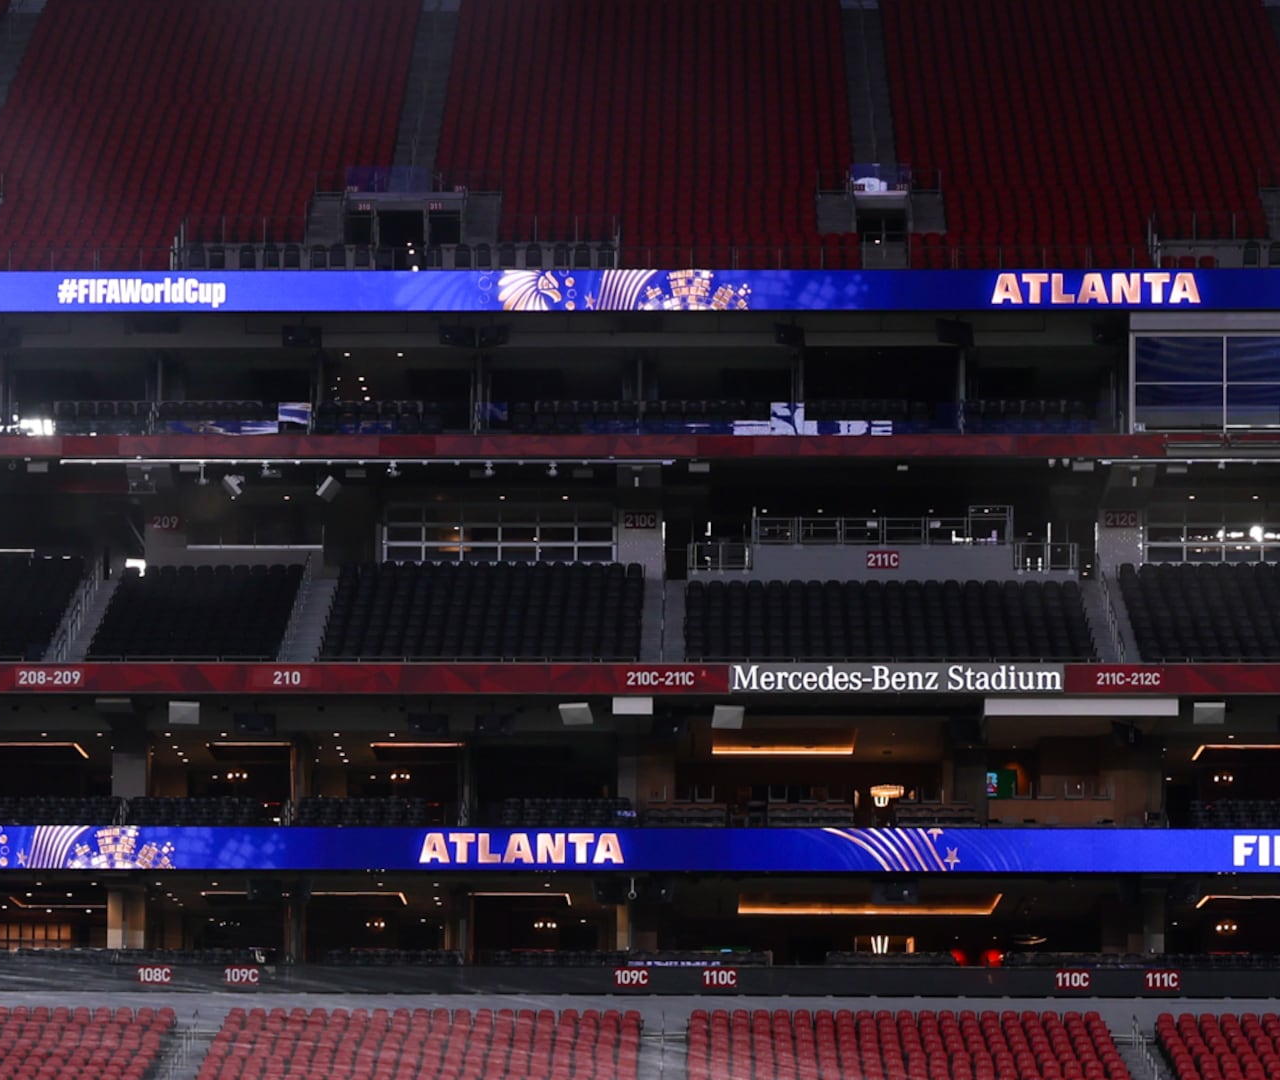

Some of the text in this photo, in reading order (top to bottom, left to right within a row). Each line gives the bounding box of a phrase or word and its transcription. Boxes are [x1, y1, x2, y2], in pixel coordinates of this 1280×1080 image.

[58, 277, 226, 308] #FIFAWorldCup
[991, 273, 1200, 304] ATLANTA
[153, 516, 179, 529] 209
[624, 513, 656, 528] 210C
[1105, 511, 1137, 526] 212C
[867, 553, 899, 568] 211C
[18, 671, 81, 685] 208-209
[273, 671, 302, 685] 210
[626, 672, 695, 685] 210C-211C
[733, 665, 1062, 690] Mercedes-Benz Stadium
[1096, 672, 1161, 685] 211C-212C
[419, 833, 624, 864] ATLANTA
[138, 967, 172, 982] 108C
[224, 968, 260, 982] 109C
[615, 969, 649, 984] 109C
[703, 970, 737, 985] 110C
[1056, 972, 1090, 987] 110C
[1146, 972, 1179, 987] 111C
